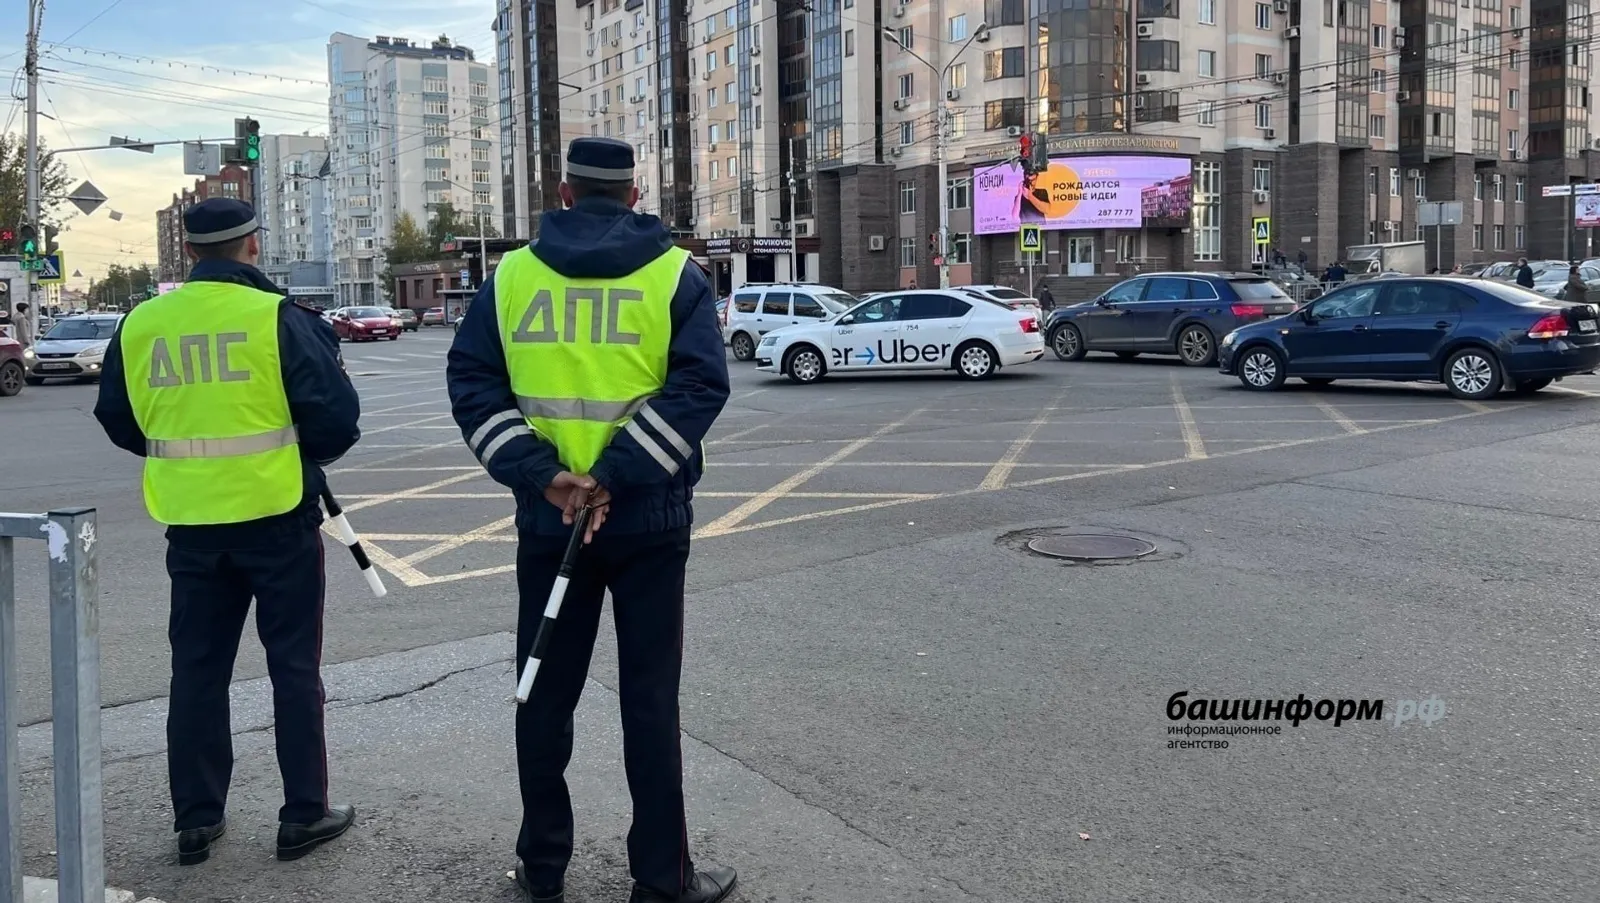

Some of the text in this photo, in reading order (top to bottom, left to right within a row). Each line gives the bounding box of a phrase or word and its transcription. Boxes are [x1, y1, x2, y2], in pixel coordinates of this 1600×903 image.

[1053, 181, 1120, 191] РОЖДАЮТСЯ
[1053, 192, 1117, 202] НОВЫЕ ИДЕИ
[1098, 209, 1112, 217] 287
[2, 231, 13, 240] 24
[753, 239, 792, 247] NOVIKOVSK
[512, 287, 644, 344] ДПС
[878, 339, 951, 364] Uber
[148, 332, 251, 388] ДПС
